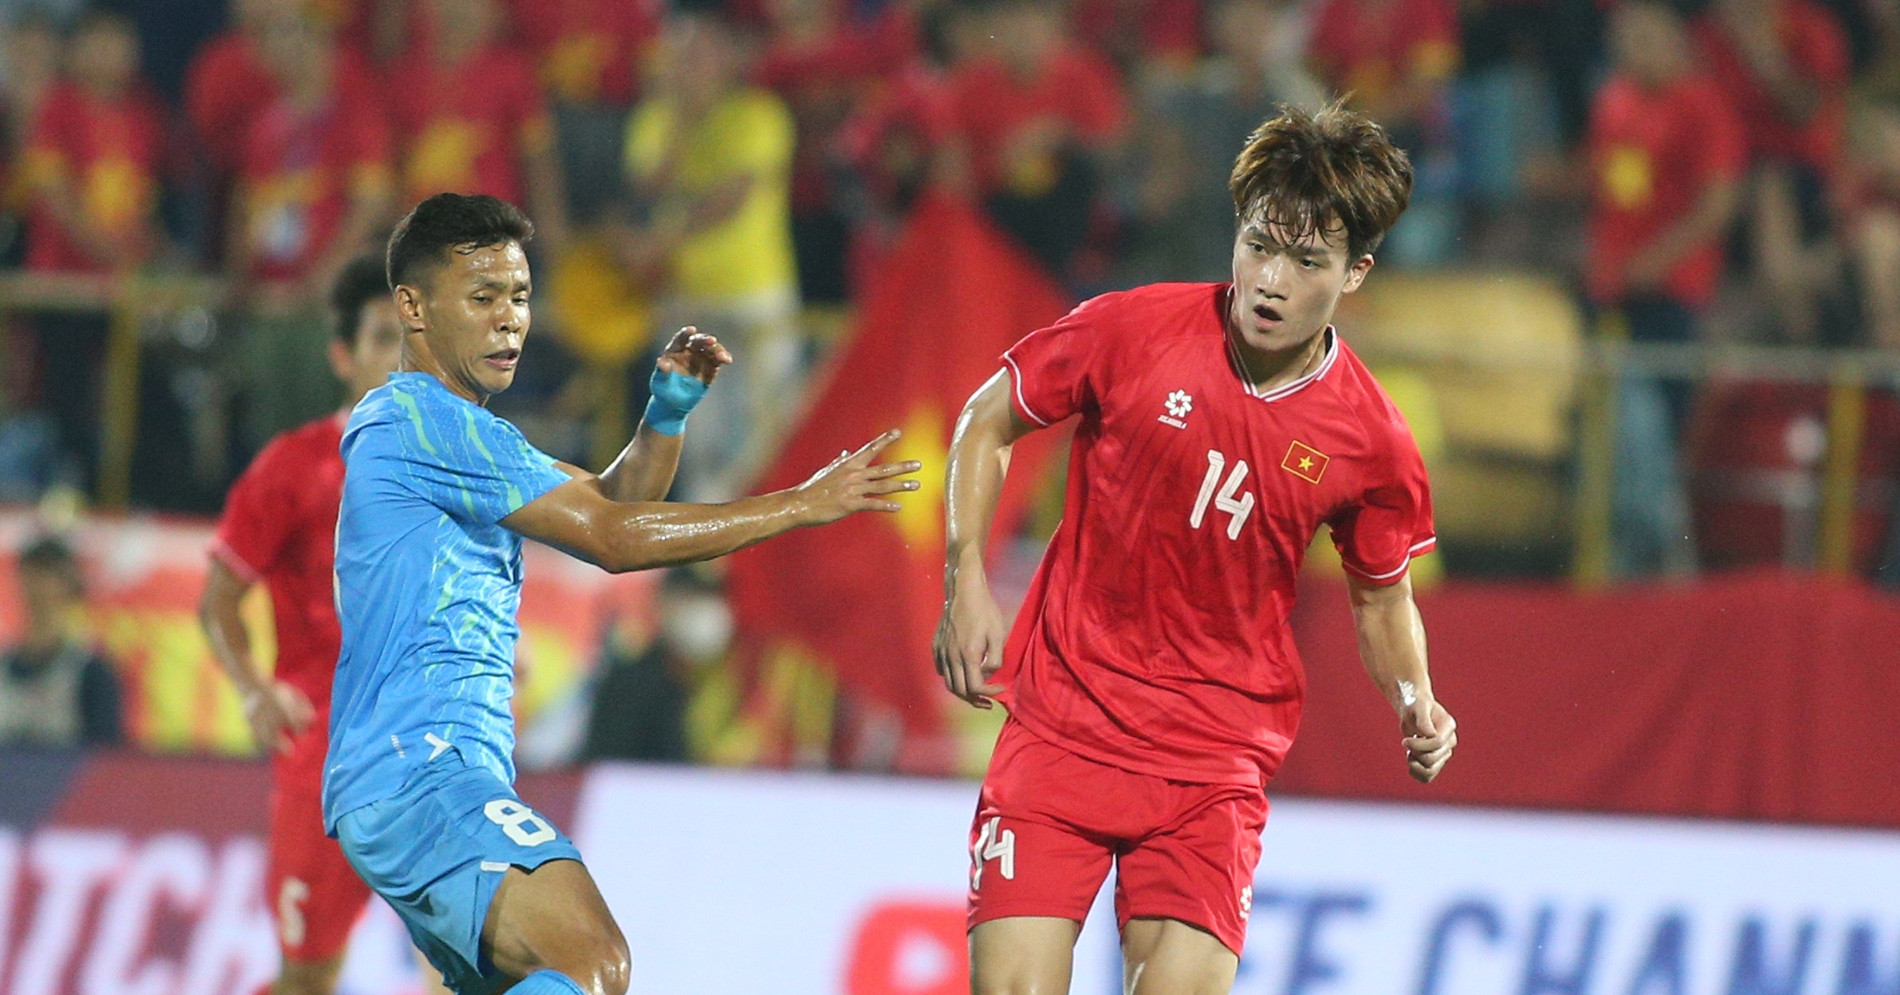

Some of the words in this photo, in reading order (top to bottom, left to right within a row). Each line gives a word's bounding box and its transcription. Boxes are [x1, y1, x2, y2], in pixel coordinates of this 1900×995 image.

[1189, 449, 1255, 541] 14
[483, 798, 557, 847] 8
[972, 816, 1016, 890] 14
[0, 826, 281, 995] TCH
